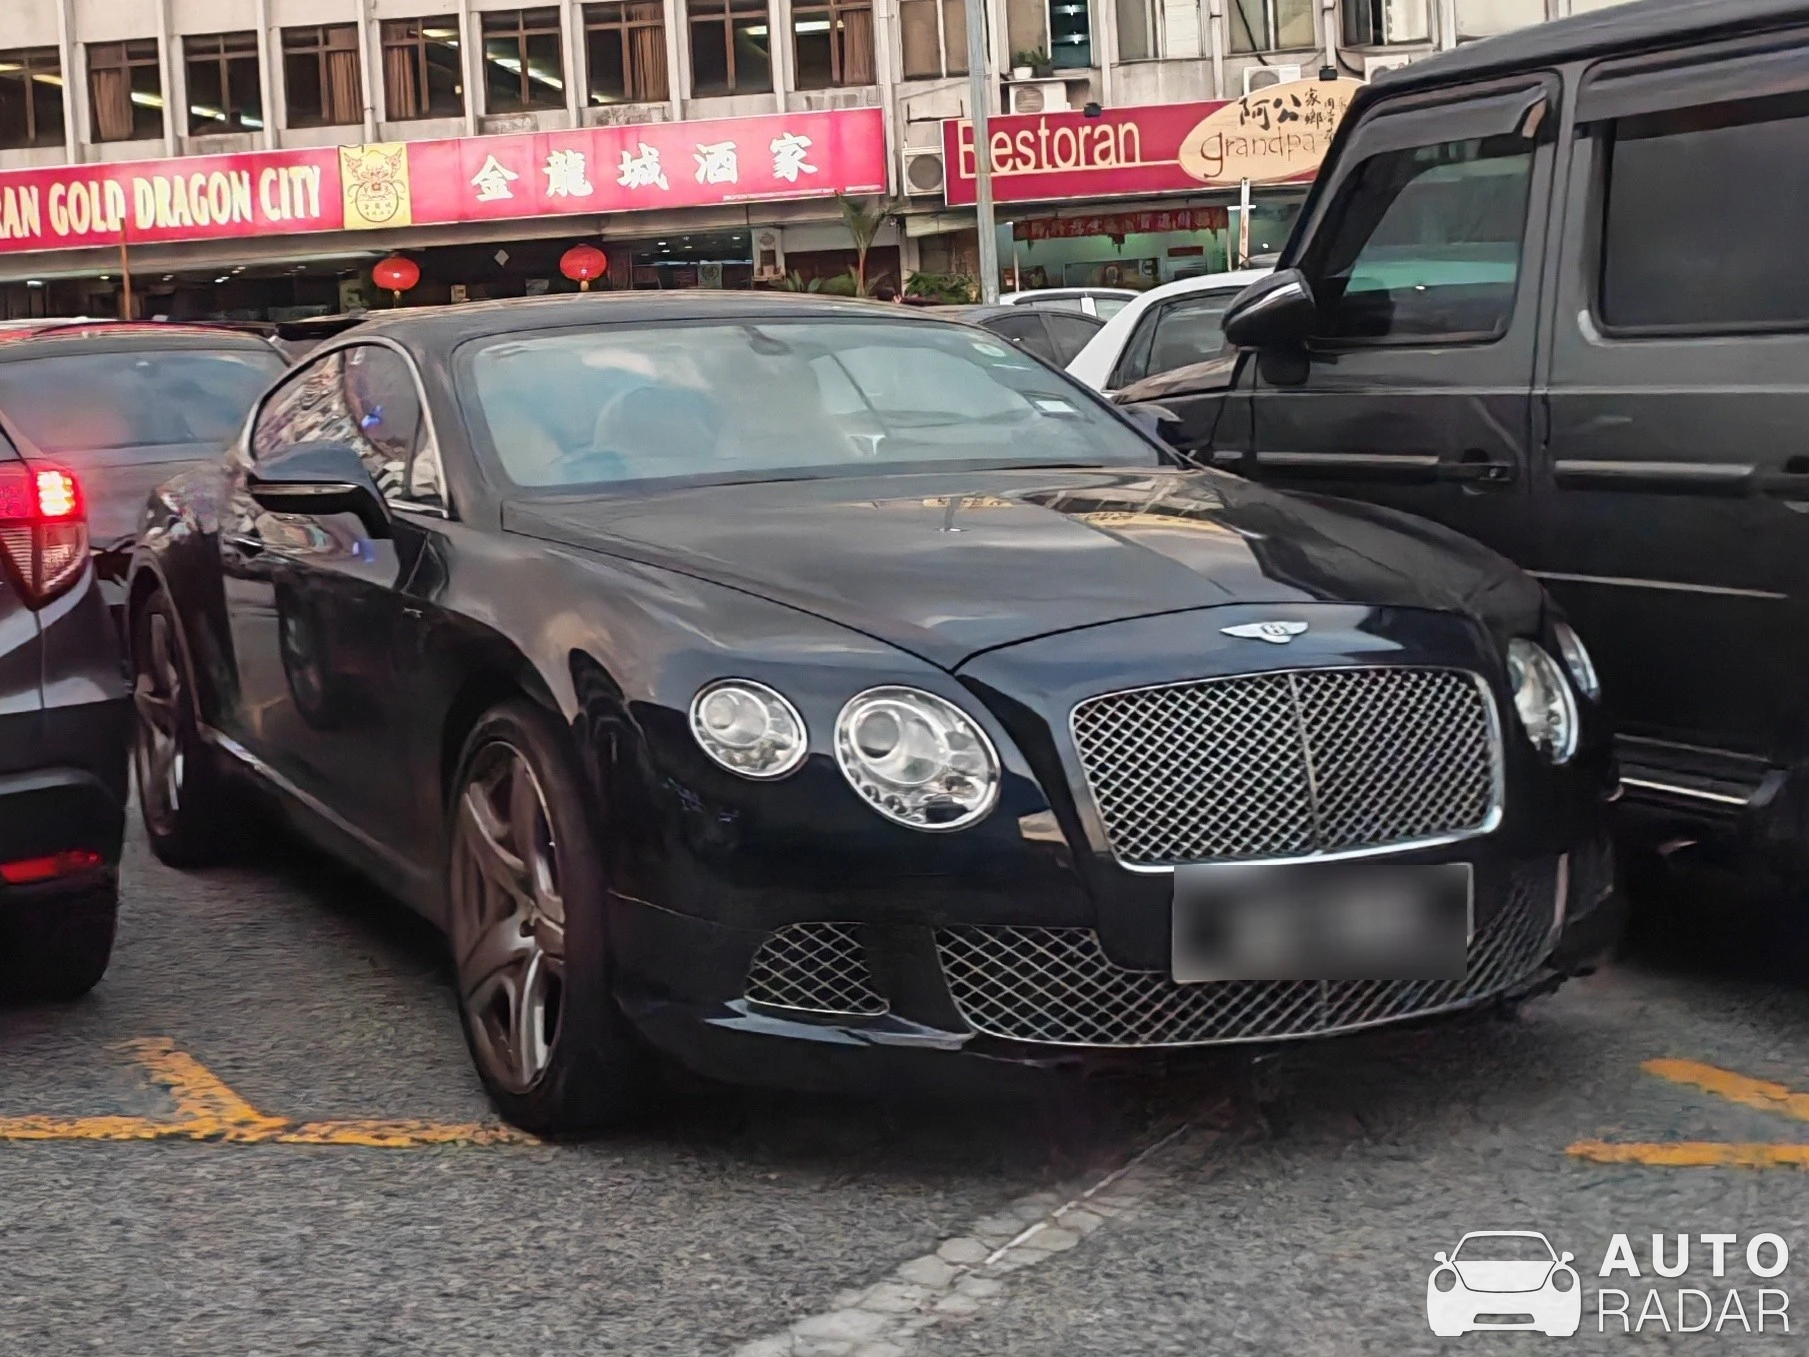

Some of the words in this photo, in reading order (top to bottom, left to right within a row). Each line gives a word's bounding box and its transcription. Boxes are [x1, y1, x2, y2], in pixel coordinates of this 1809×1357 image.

[1239, 93, 1302, 131] 阿公
[0, 184, 41, 240] AN
[48, 181, 126, 237] GOLD
[133, 169, 253, 230] DRAGON
[259, 164, 321, 221] CITY
[471, 132, 818, 203] 金龍城酒家
